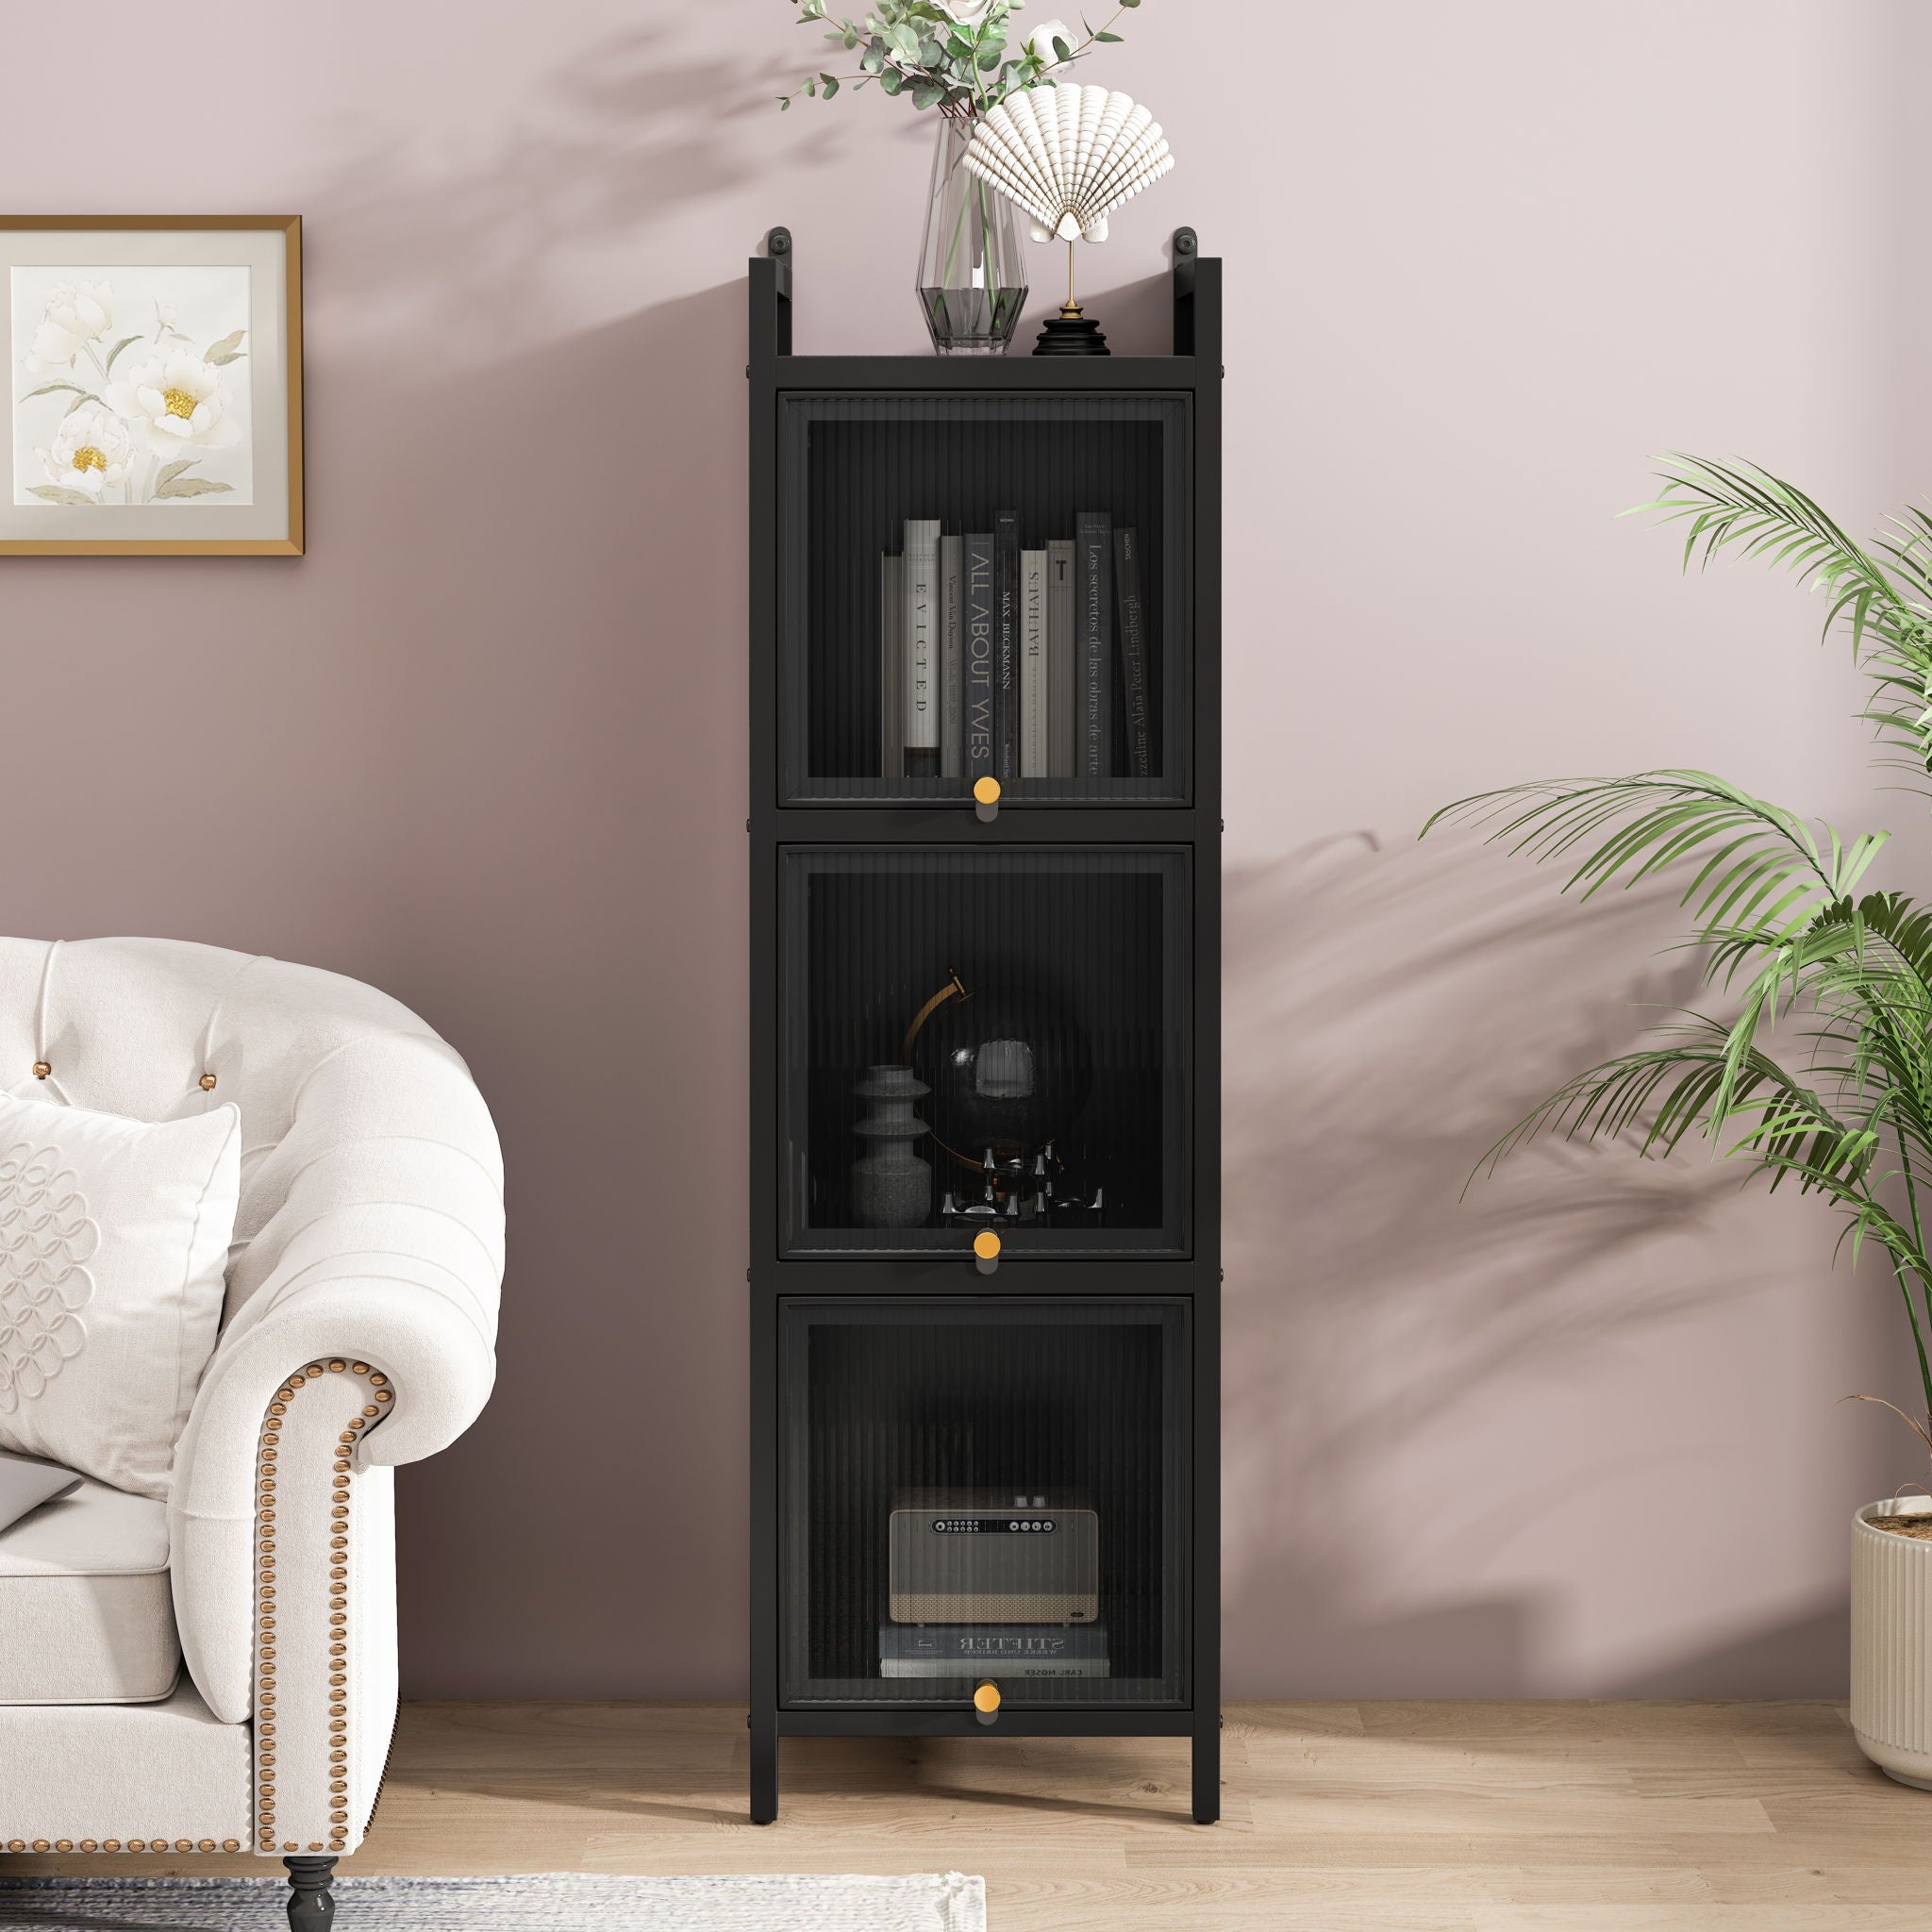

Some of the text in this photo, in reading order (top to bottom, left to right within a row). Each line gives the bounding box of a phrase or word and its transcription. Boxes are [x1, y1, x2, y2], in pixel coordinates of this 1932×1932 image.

[916, 583, 927, 712] EVICTED
[971, 552, 989, 759] ALL ABOUT YVES
[1003, 591, 1011, 690] MAX BECKMANN
[1028, 572, 1040, 657] BAUHAUS
[1089, 544, 1102, 775] Los secretos de las obras de arte
[1124, 595, 1142, 658] Lindbergh
[1129, 660, 1142, 691] Peter
[1132, 731, 1148, 776] zzedine
